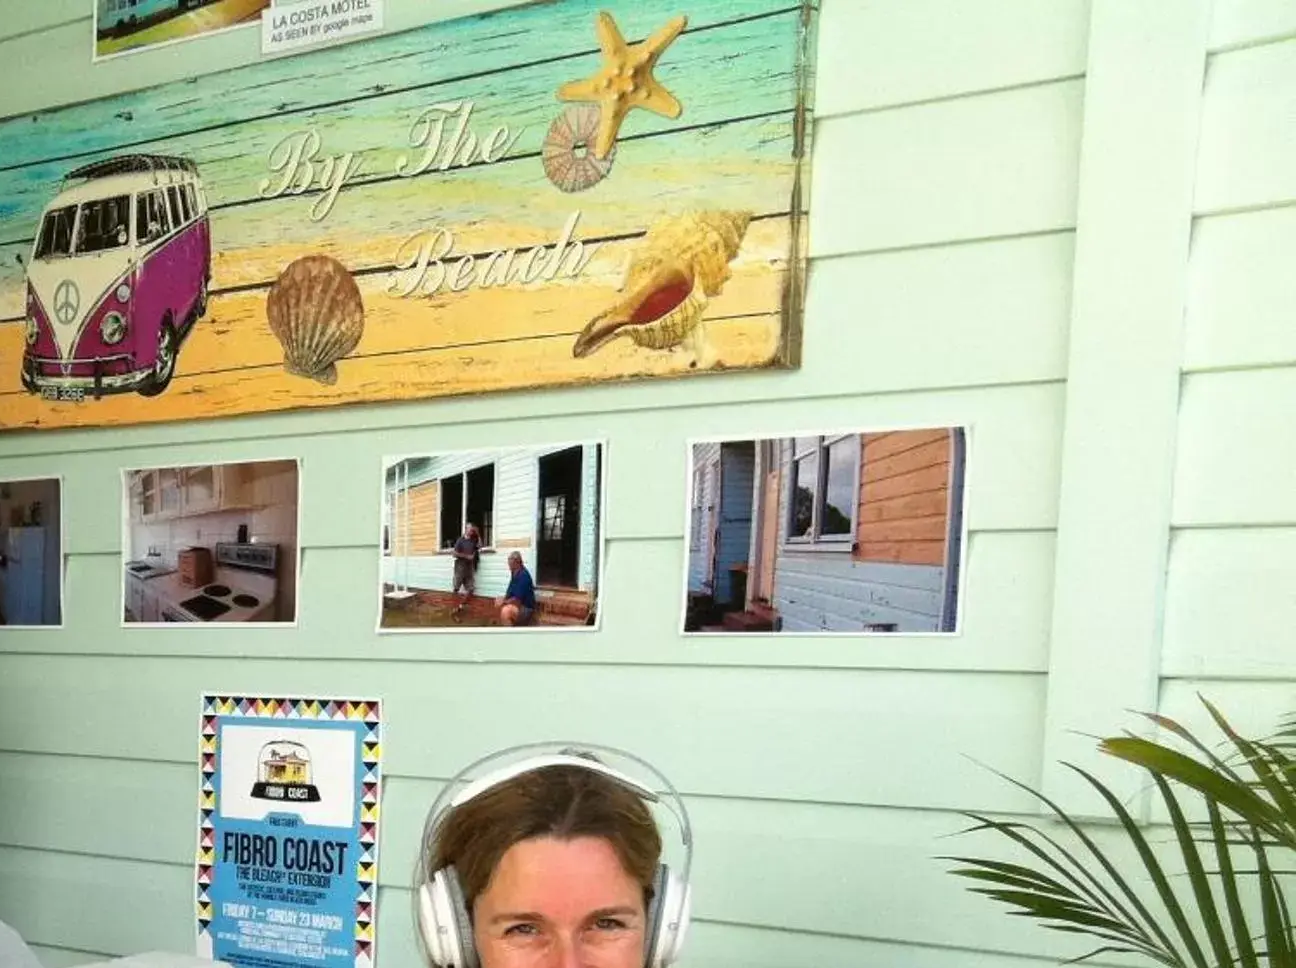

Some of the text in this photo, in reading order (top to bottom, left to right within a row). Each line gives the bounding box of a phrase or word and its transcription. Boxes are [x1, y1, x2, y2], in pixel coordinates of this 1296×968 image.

[272, 0, 371, 30] LA COSTA MOTEL
[259, 99, 526, 222] By The
[386, 209, 601, 298] Beach
[223, 831, 349, 875] FIBRO COAST
[288, 871, 331, 889] EXTENSION
[266, 907, 297, 925] SUNDAY
[298, 911, 310, 927] 23
